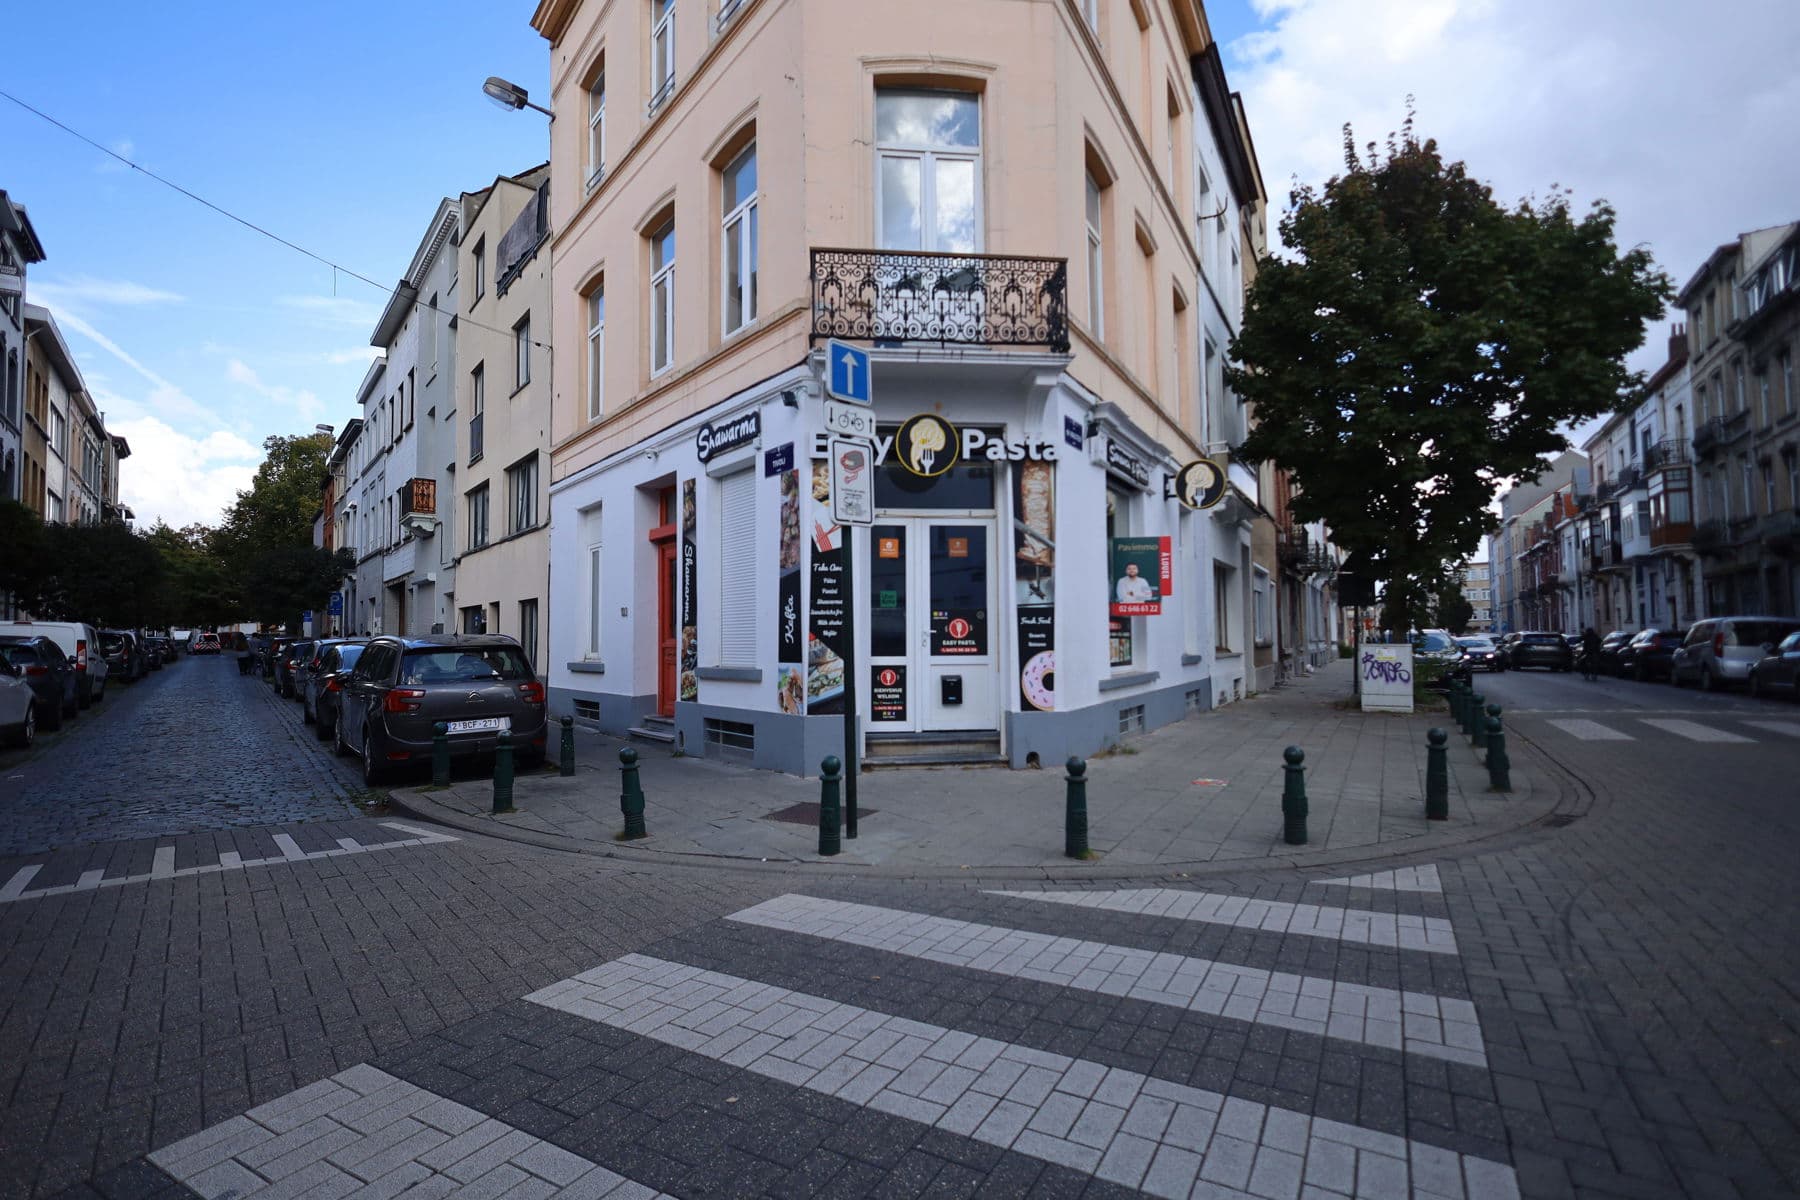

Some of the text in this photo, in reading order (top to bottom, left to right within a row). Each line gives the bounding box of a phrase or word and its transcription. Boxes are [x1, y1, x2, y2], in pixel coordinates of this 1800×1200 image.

[698, 417, 756, 459] Shawarma
[962, 428, 1059, 461] Pasta
[684, 545, 694, 624] Shawarma
[1161, 557, 1169, 579] LOUER
[784, 594, 796, 644] Kefta
